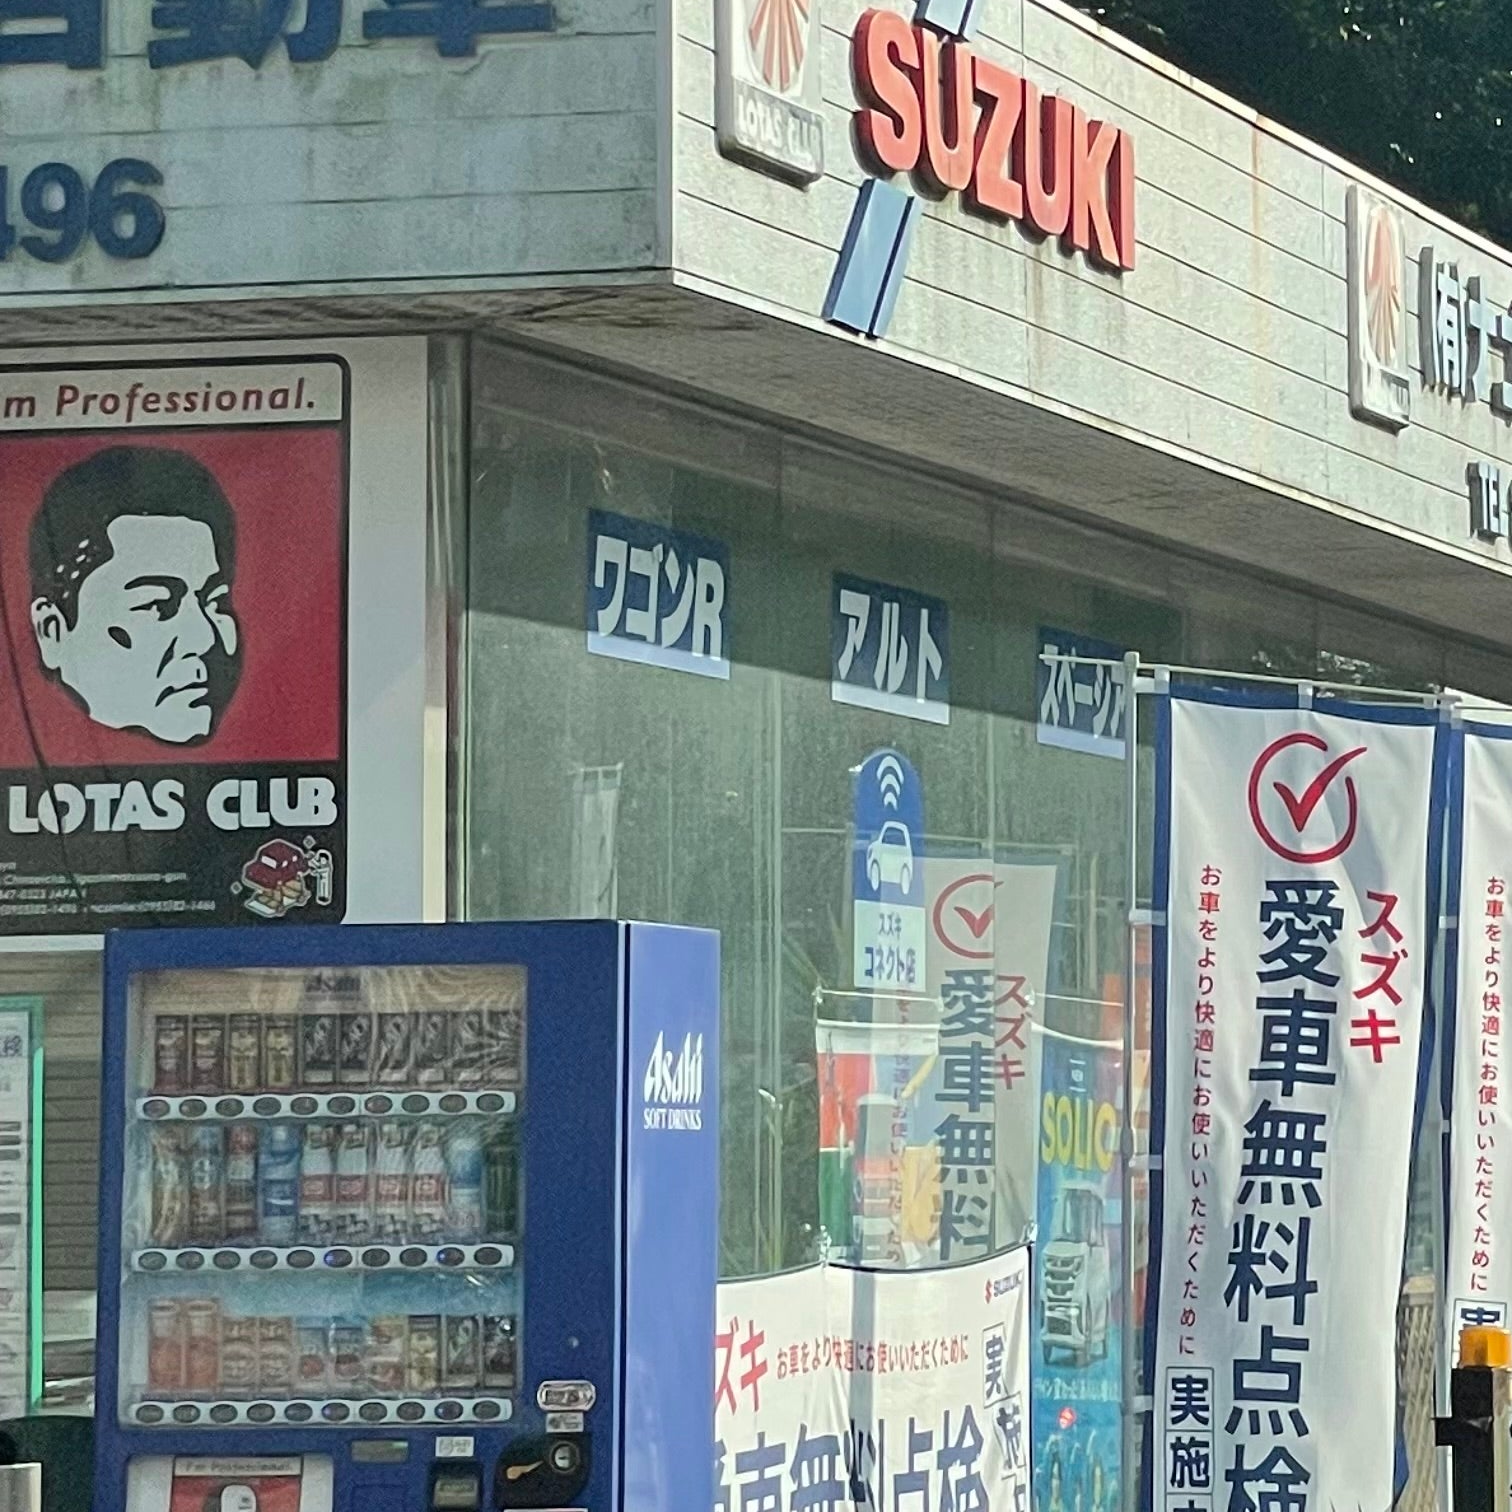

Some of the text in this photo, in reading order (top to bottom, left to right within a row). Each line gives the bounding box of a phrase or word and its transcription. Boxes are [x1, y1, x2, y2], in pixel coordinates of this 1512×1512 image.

[850, 7, 1135, 272] SUZUKI
[0, 157, 166, 263] 96
[56, 377, 316, 423] Professional.
[595, 534, 725, 660] ワゴンR
[838, 588, 943, 703] アルト
[9, 777, 338, 833] LOTAS CLUB
[864, 946, 917, 985] コネクト店
[1350, 890, 1408, 1064] スズキ
[644, 1030, 703, 1104] Asahi
[1178, 864, 1222, 1356] お車をより快適にお使いいただくために
[1470, 876, 1505, 1292] お車をより快適にお使いいただくために
[1222, 879, 1346, 1512] 愛車無料点検
[1168, 1374, 1212, 1512] 実施
